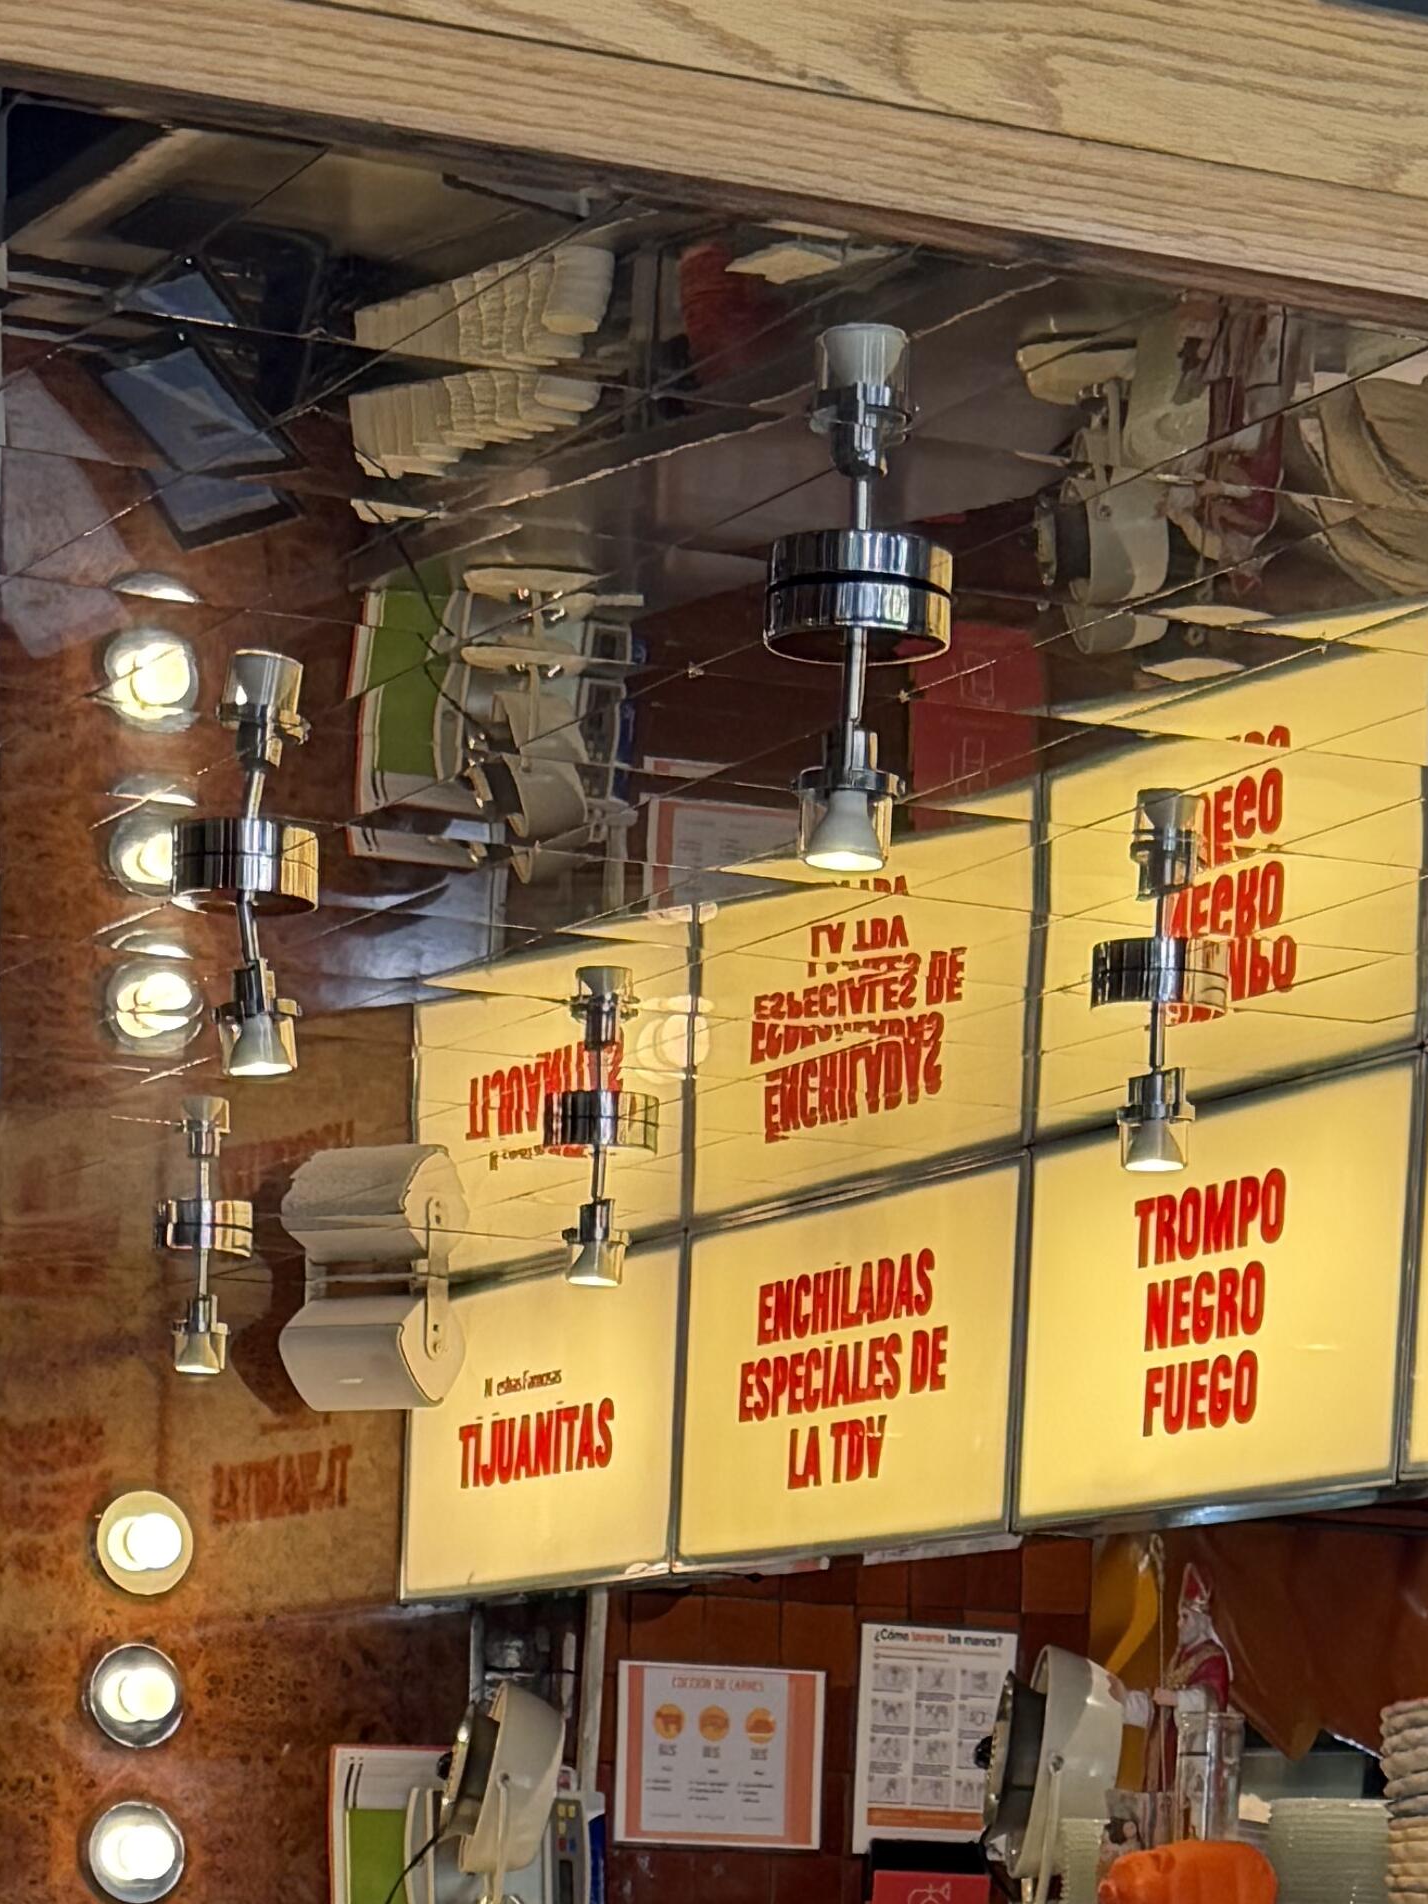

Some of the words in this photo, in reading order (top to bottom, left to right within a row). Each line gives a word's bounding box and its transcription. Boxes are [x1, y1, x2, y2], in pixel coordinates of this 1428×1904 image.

[1134, 1167, 1287, 1269] TROMPO
[757, 1247, 936, 1347] ENCHILADAS
[1143, 1260, 1266, 1352] NEGRO
[738, 1332, 904, 1423] ESPECIALES
[909, 1324, 949, 1395] DE
[1143, 1349, 1259, 1438] FUEGO
[458, 1397, 615, 1490] TIJUANITAS
[787, 1425, 823, 1490] LA
[830, 1414, 888, 1485] TDV
